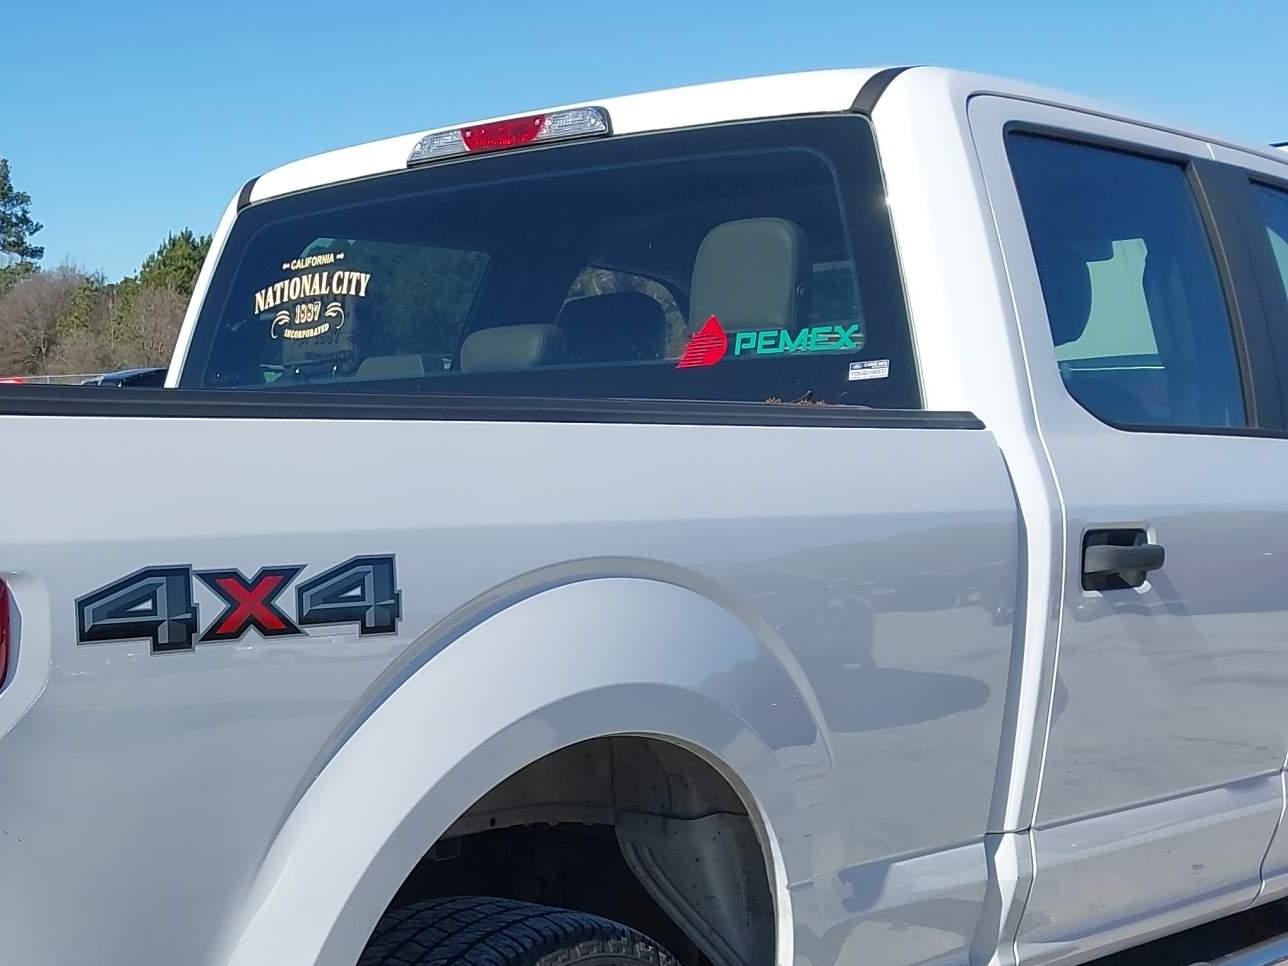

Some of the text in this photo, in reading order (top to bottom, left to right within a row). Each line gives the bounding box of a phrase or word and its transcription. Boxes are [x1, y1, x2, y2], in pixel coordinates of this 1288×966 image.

[291, 253, 334, 270] CALIFORNIA
[255, 271, 371, 315] NATIONAL CITY
[284, 323, 330, 339] INCORPORATED
[734, 324, 859, 356] PEMEX
